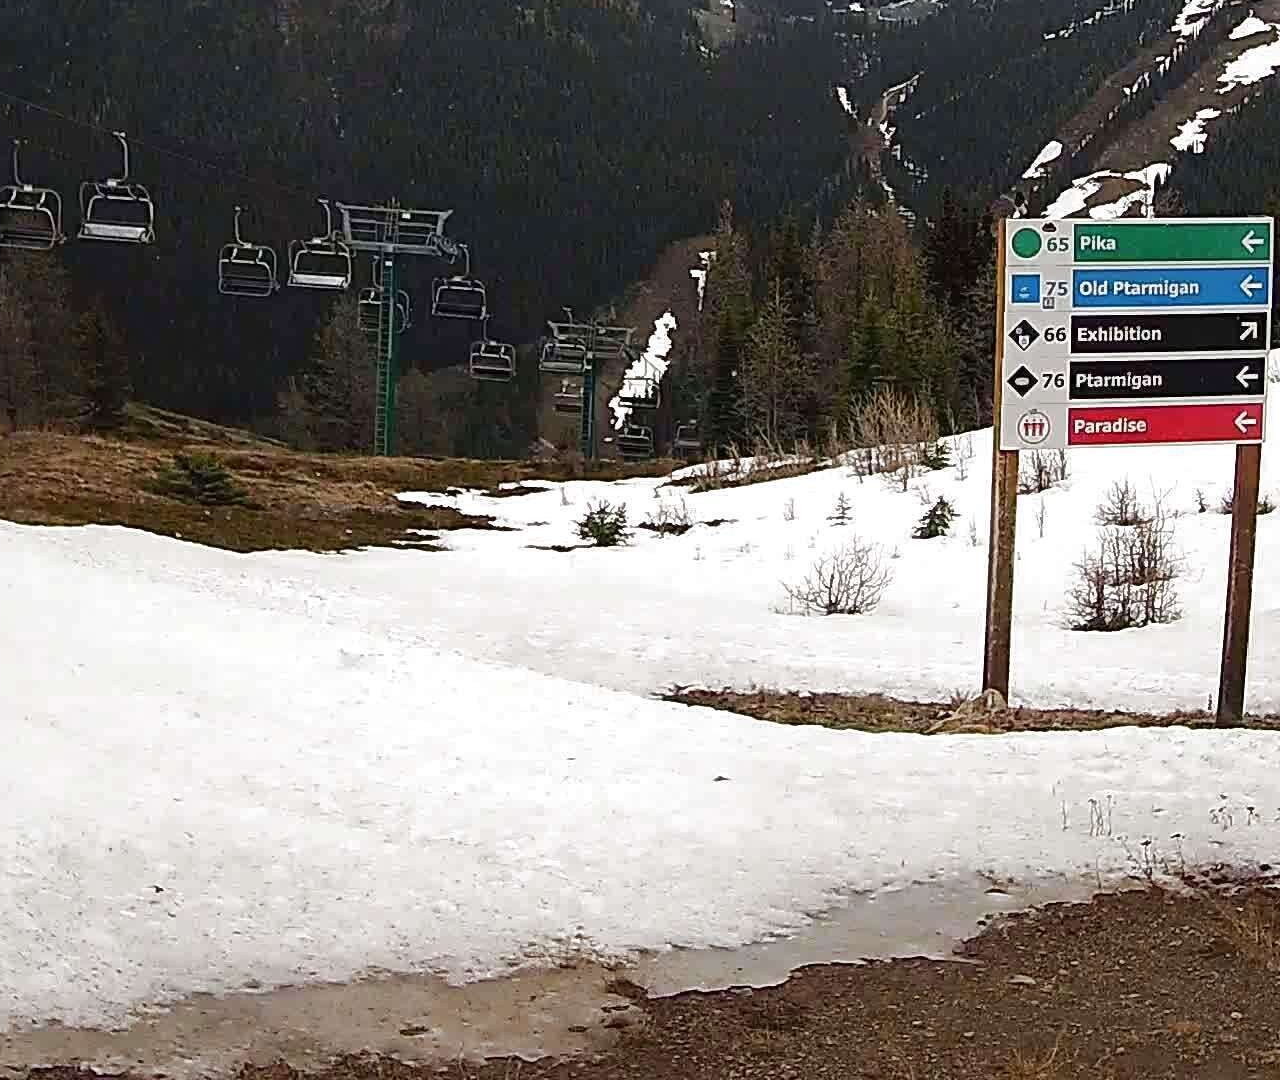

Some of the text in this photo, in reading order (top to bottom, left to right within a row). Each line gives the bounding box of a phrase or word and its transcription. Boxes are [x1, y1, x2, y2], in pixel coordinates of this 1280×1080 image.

[1046, 235, 1116, 252] 65 Pika
[1045, 280, 1200, 297] 75 Old Ptarmigan
[1043, 326, 1162, 342] 66 Exhibition
[1041, 372, 1163, 390] 76 Ptarmigan
[1074, 417, 1147, 434] Paradise
